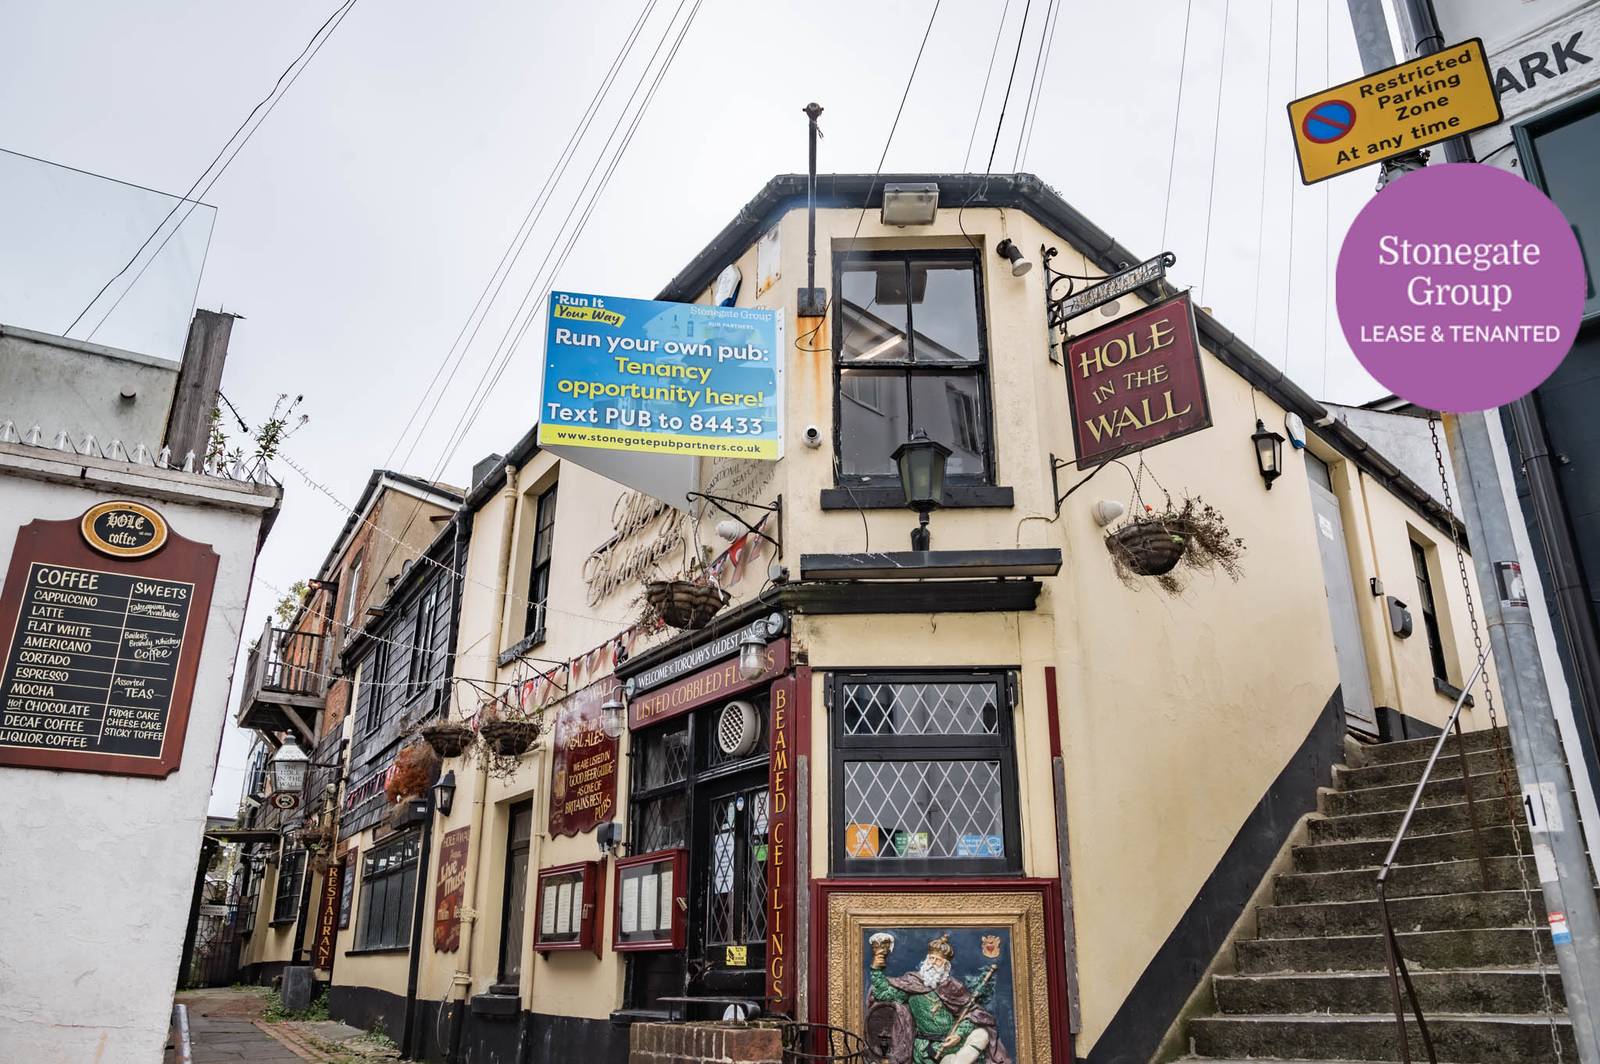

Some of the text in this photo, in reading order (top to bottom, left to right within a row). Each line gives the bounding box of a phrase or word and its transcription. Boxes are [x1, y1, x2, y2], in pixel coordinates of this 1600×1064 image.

[1359, 50, 1472, 98] Restricted
[1377, 73, 1461, 110] Parking
[1397, 95, 1449, 121] Zone
[1336, 116, 1460, 165] At any time
[558, 294, 604, 309] Run It
[557, 305, 621, 326] Your Way
[690, 306, 772, 323] Stonegate Group
[555, 328, 769, 363] Run your own pub:
[1078, 318, 1176, 379] HOLE
[614, 356, 712, 385] Tenancy
[557, 379, 765, 408] opportunity here!
[1092, 364, 1169, 404] IN THE
[547, 403, 763, 435] Text PUB to 84433
[1085, 390, 1192, 444] WALL
[557, 431, 761, 453] www.stonegatepubpartners.co.uk
[106, 512, 145, 530] HOLE
[109, 531, 137, 546] coffee
[36, 567, 100, 591] COFFEE
[33, 590, 98, 607] CAPPUCCINO
[134, 582, 187, 600] SWEETS
[31, 605, 65, 619] LATTE
[27, 620, 92, 638] FLAT WHITE
[23, 636, 92, 654] AMERICANO
[134, 647, 173, 661] Coffee
[19, 651, 71, 666] CORTADO
[638, 665, 669, 688] WELCOME
[674, 646, 711, 673] TORQUAY'S
[711, 633, 740, 657] OLDEST
[15, 666, 69, 682] ESPRESSO
[114, 677, 146, 687] Assorted
[10, 682, 54, 698] MOCHA
[636, 649, 775, 722] LISTED COBBLED FLS
[24, 699, 91, 717] CHOCOLATE
[109, 707, 160, 721] FUDGE CAKE
[4, 714, 85, 733] DECAF COFFEE
[106, 717, 162, 731] CHEESE CAKE
[0, 729, 88, 748] LIQUOR COFFEE
[104, 727, 164, 741] STICKY TOFFEE
[773, 689, 788, 814] BEAMED
[1525, 795, 1536, 826] 1
[319, 867, 338, 966] RESTAURANT
[771, 822, 785, 1003] CEILINGS
